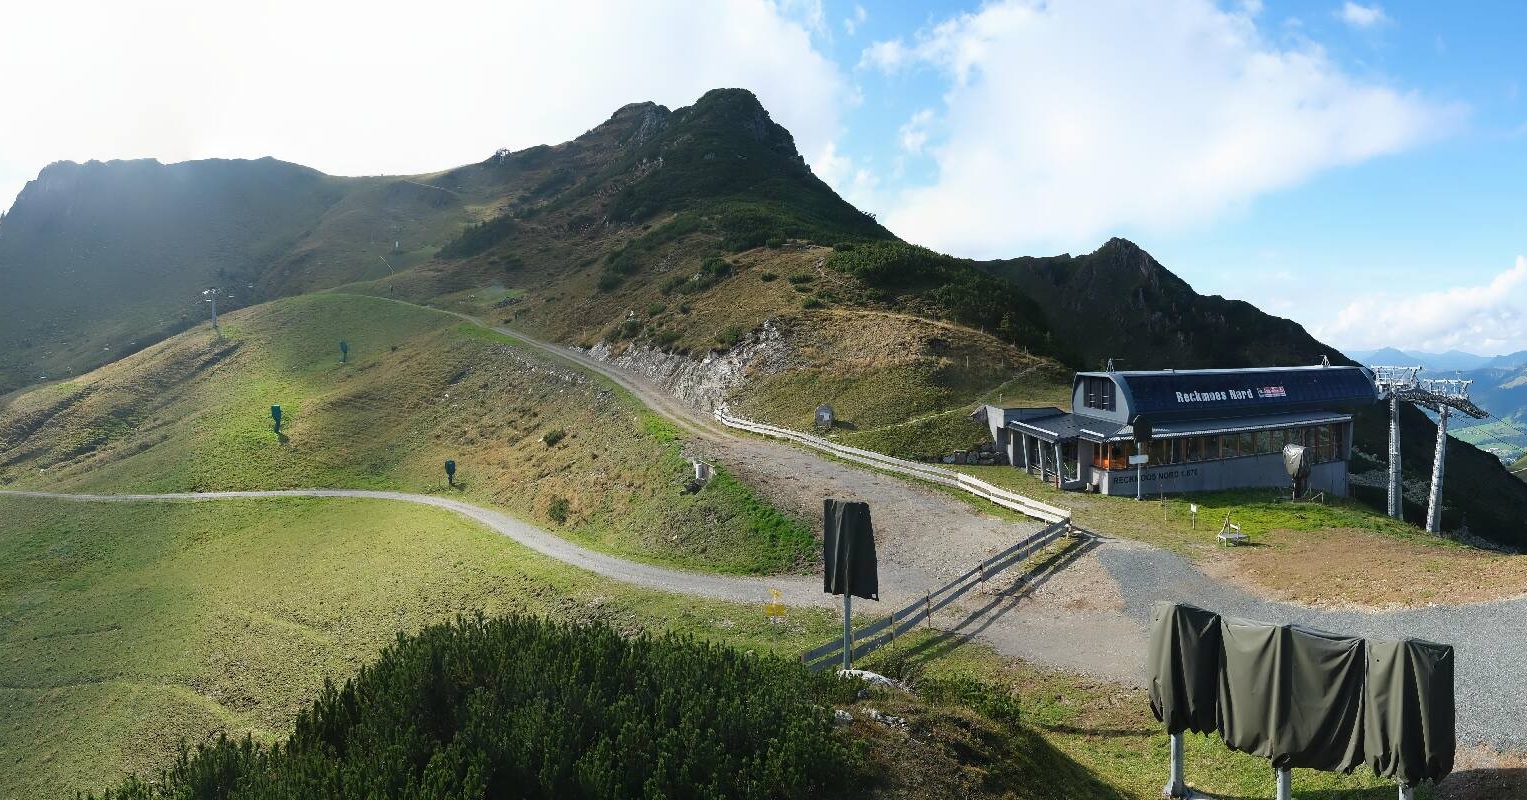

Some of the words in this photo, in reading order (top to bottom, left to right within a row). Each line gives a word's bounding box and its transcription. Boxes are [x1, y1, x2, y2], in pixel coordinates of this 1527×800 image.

[1175, 391, 1227, 403] Reckmoos
[1228, 388, 1254, 400] Nord
[1158, 470, 1179, 480] NORD
